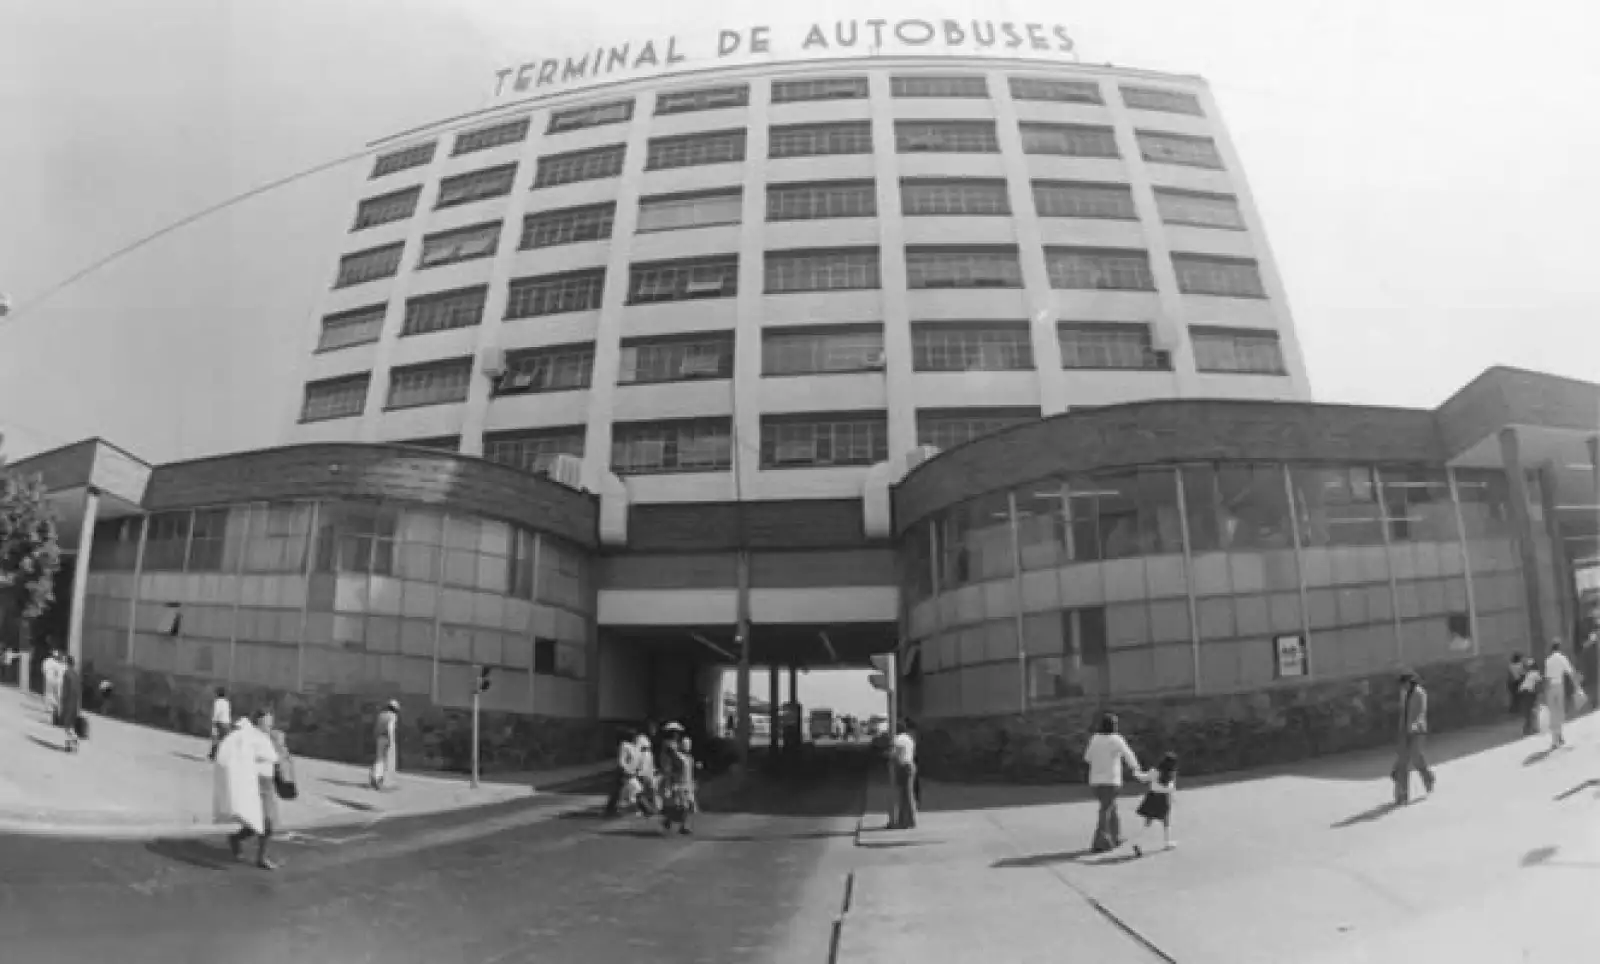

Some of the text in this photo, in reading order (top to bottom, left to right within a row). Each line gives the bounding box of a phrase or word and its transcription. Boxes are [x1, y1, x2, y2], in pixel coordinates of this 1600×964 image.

[495, 19, 1075, 95] TERMINAL DE AUTOBUSES
